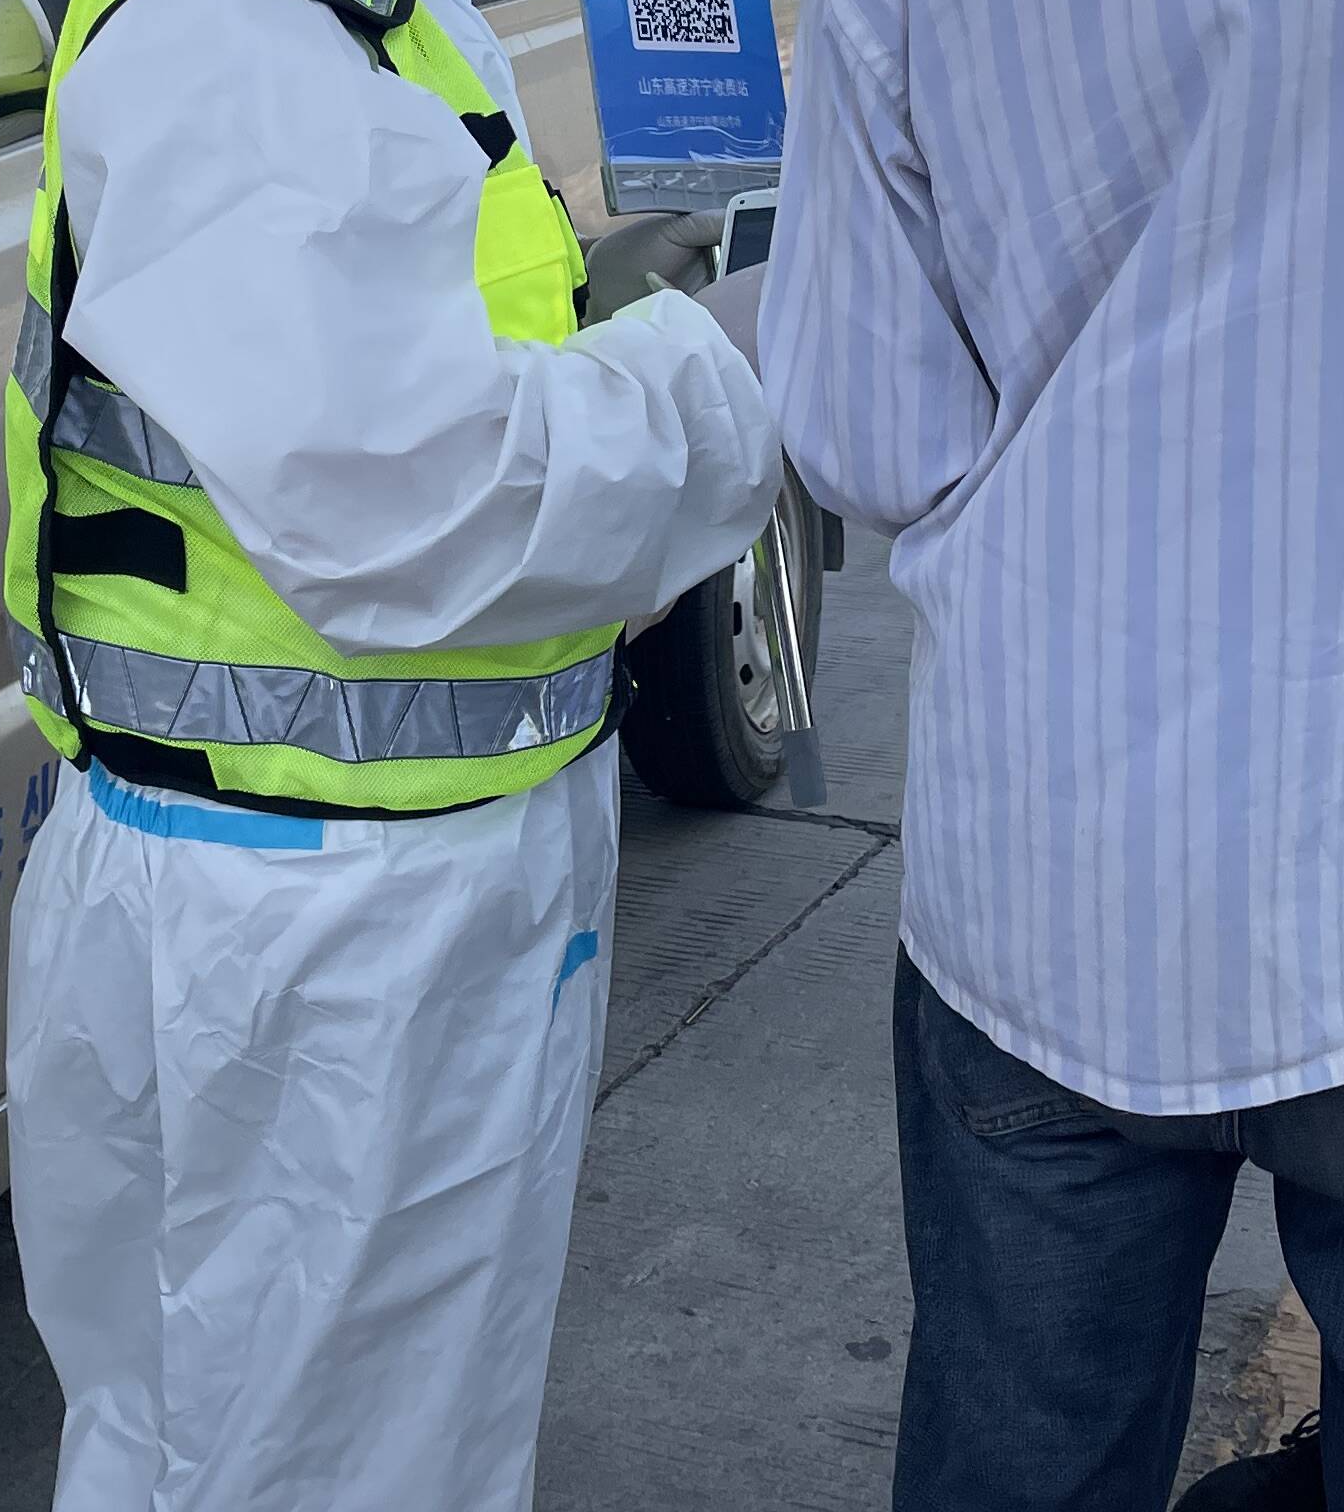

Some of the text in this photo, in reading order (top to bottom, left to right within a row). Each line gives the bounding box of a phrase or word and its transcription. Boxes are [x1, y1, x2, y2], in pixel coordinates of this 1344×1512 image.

[639, 76, 749, 97] 山东高速济宁收费站
